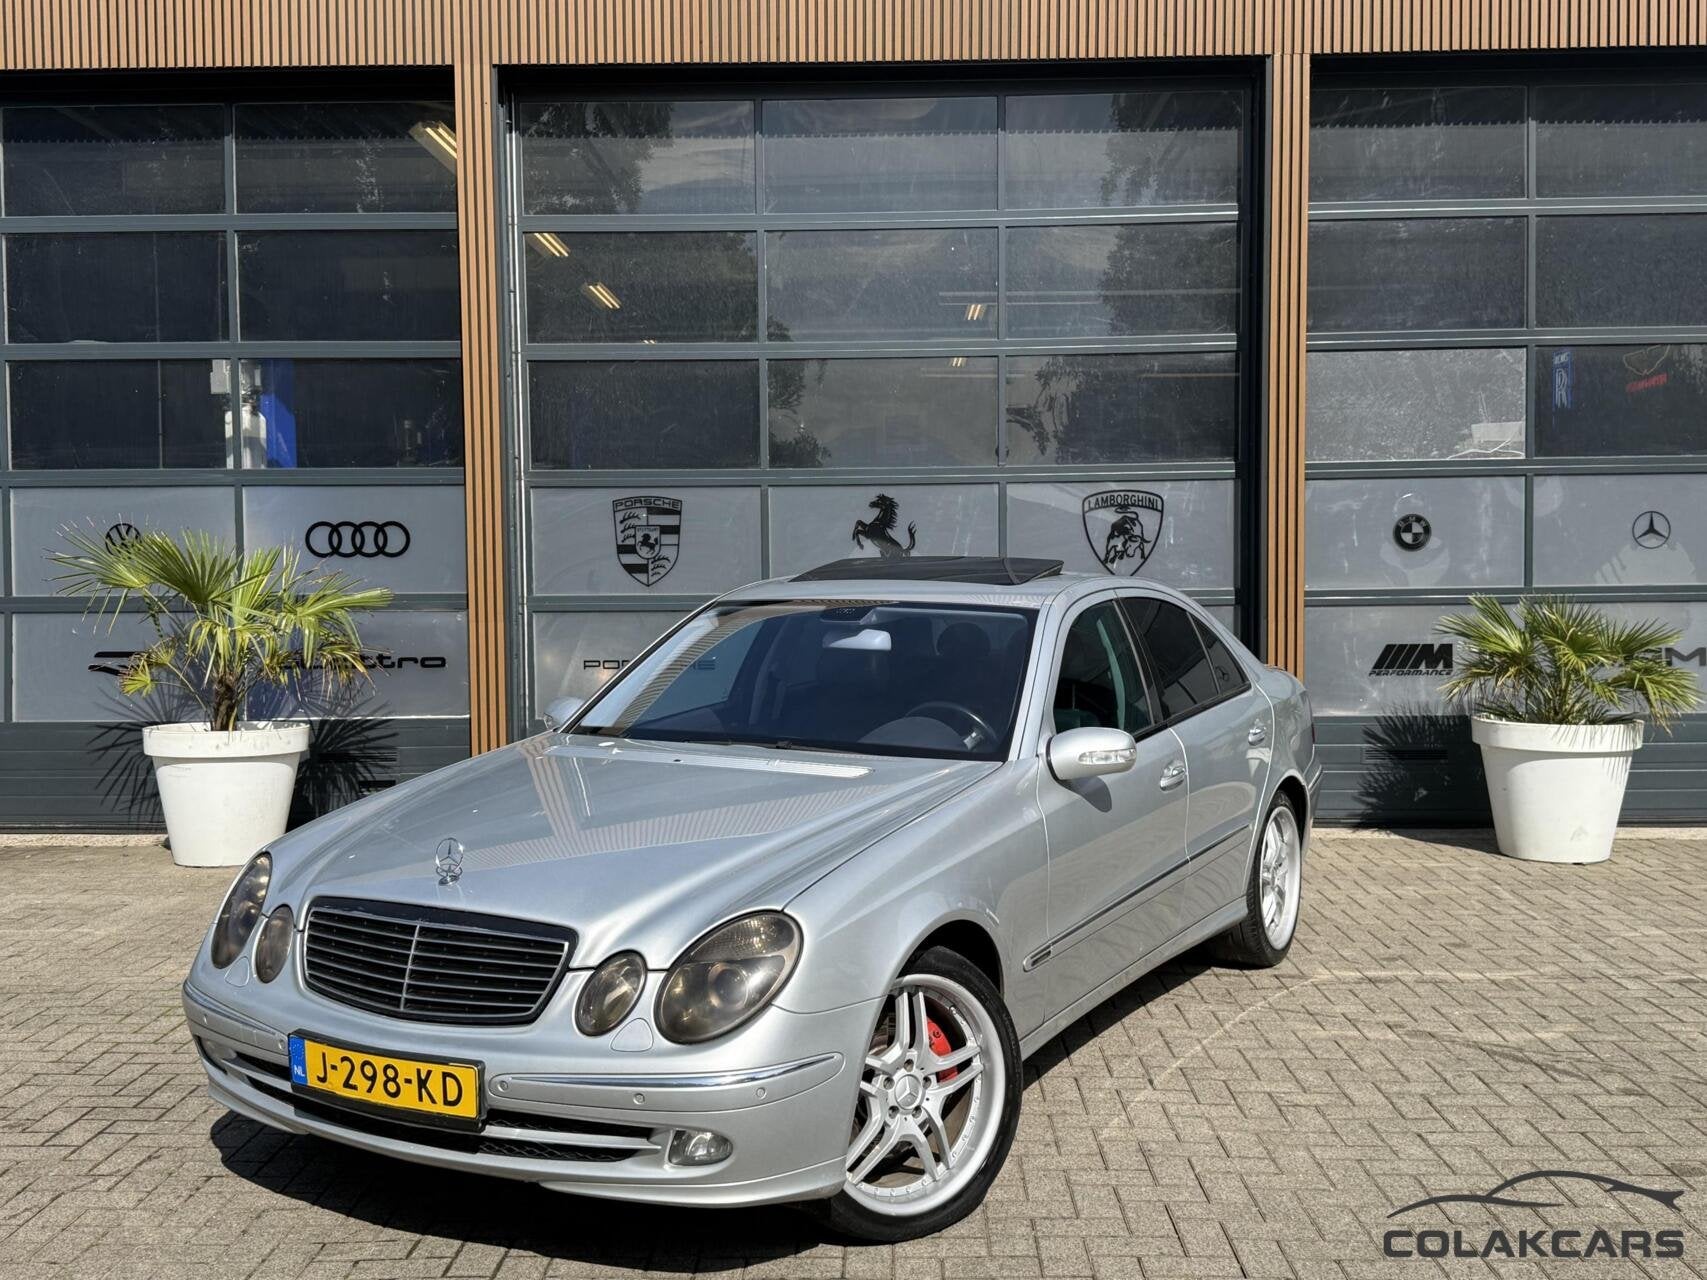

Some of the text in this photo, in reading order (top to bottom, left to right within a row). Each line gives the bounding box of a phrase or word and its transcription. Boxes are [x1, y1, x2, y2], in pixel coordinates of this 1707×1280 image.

[615, 498, 680, 510] PORSCHE
[1088, 494, 1159, 510] LAMBORGHINI
[1368, 669, 1454, 677] PERFORMANCE
[294, 1065, 305, 1077] NL
[316, 1052, 463, 1107] J-298-KD
